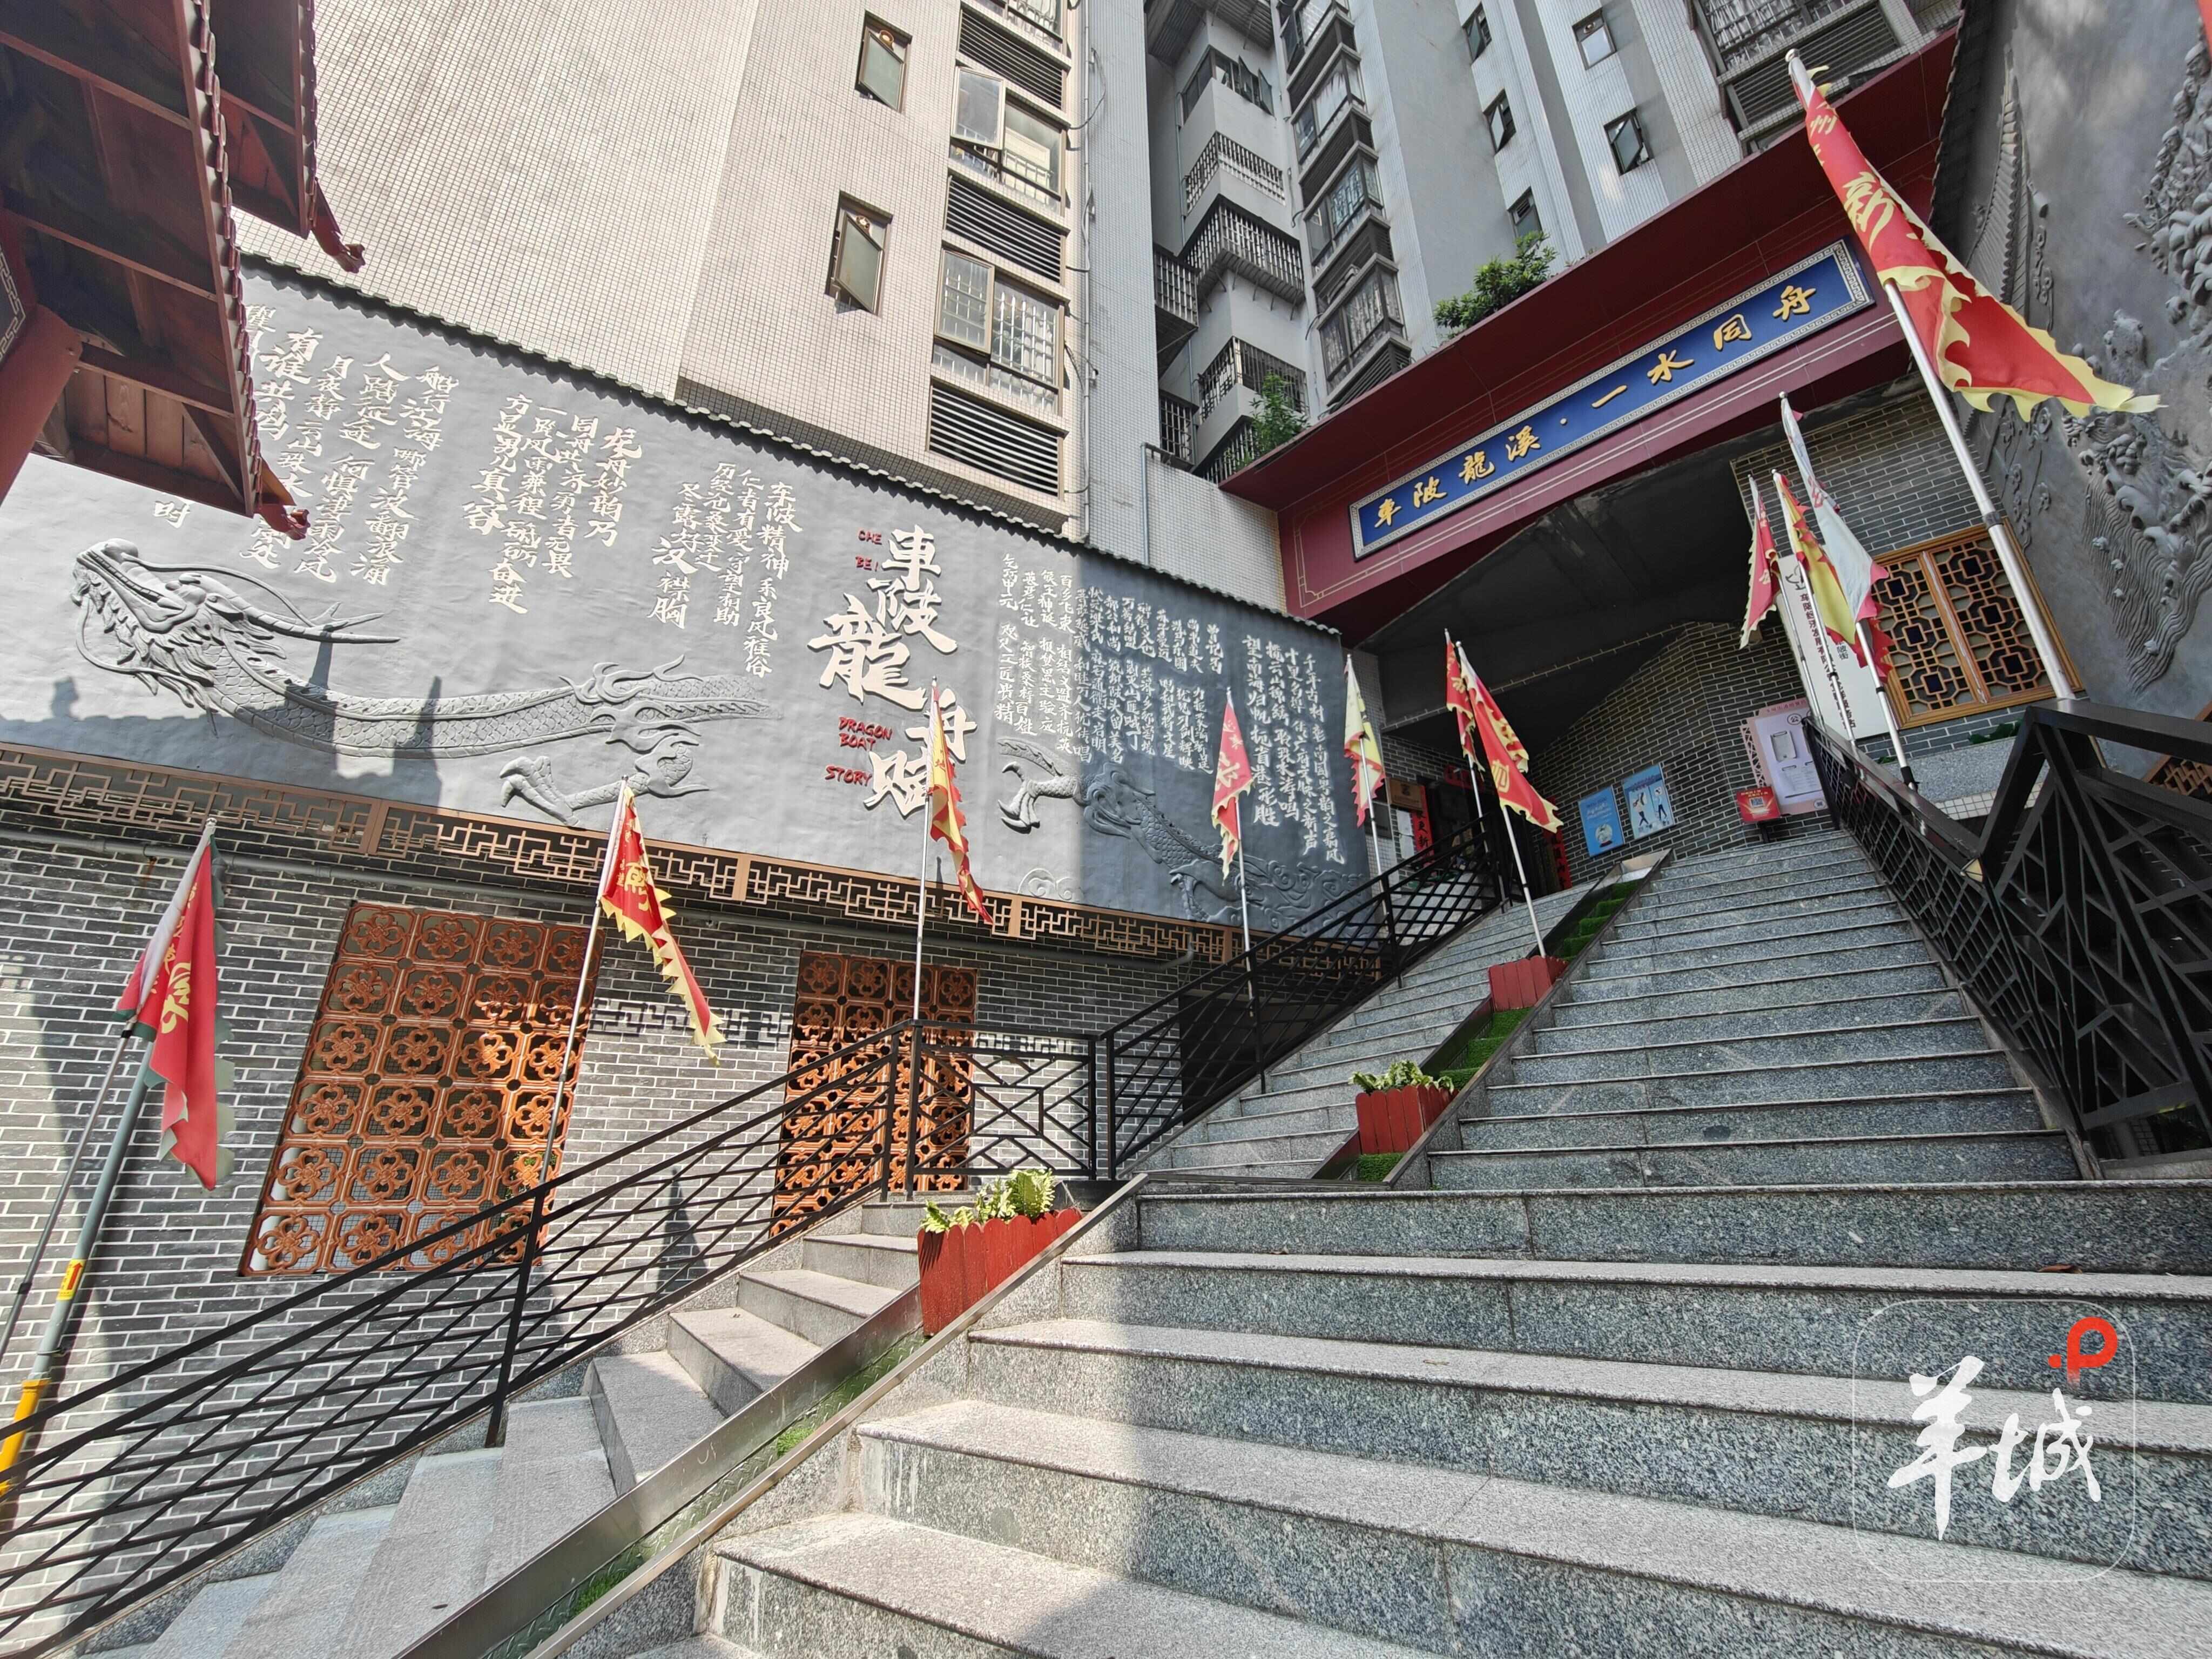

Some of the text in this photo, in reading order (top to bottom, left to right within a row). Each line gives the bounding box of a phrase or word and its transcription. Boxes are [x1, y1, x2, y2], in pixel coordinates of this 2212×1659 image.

[858, 528, 882, 545] CHE
[855, 555, 879, 572] BEI
[838, 717, 893, 740] DRAGON
[838, 732, 877, 752] BOAT
[824, 765, 874, 787] STORY
